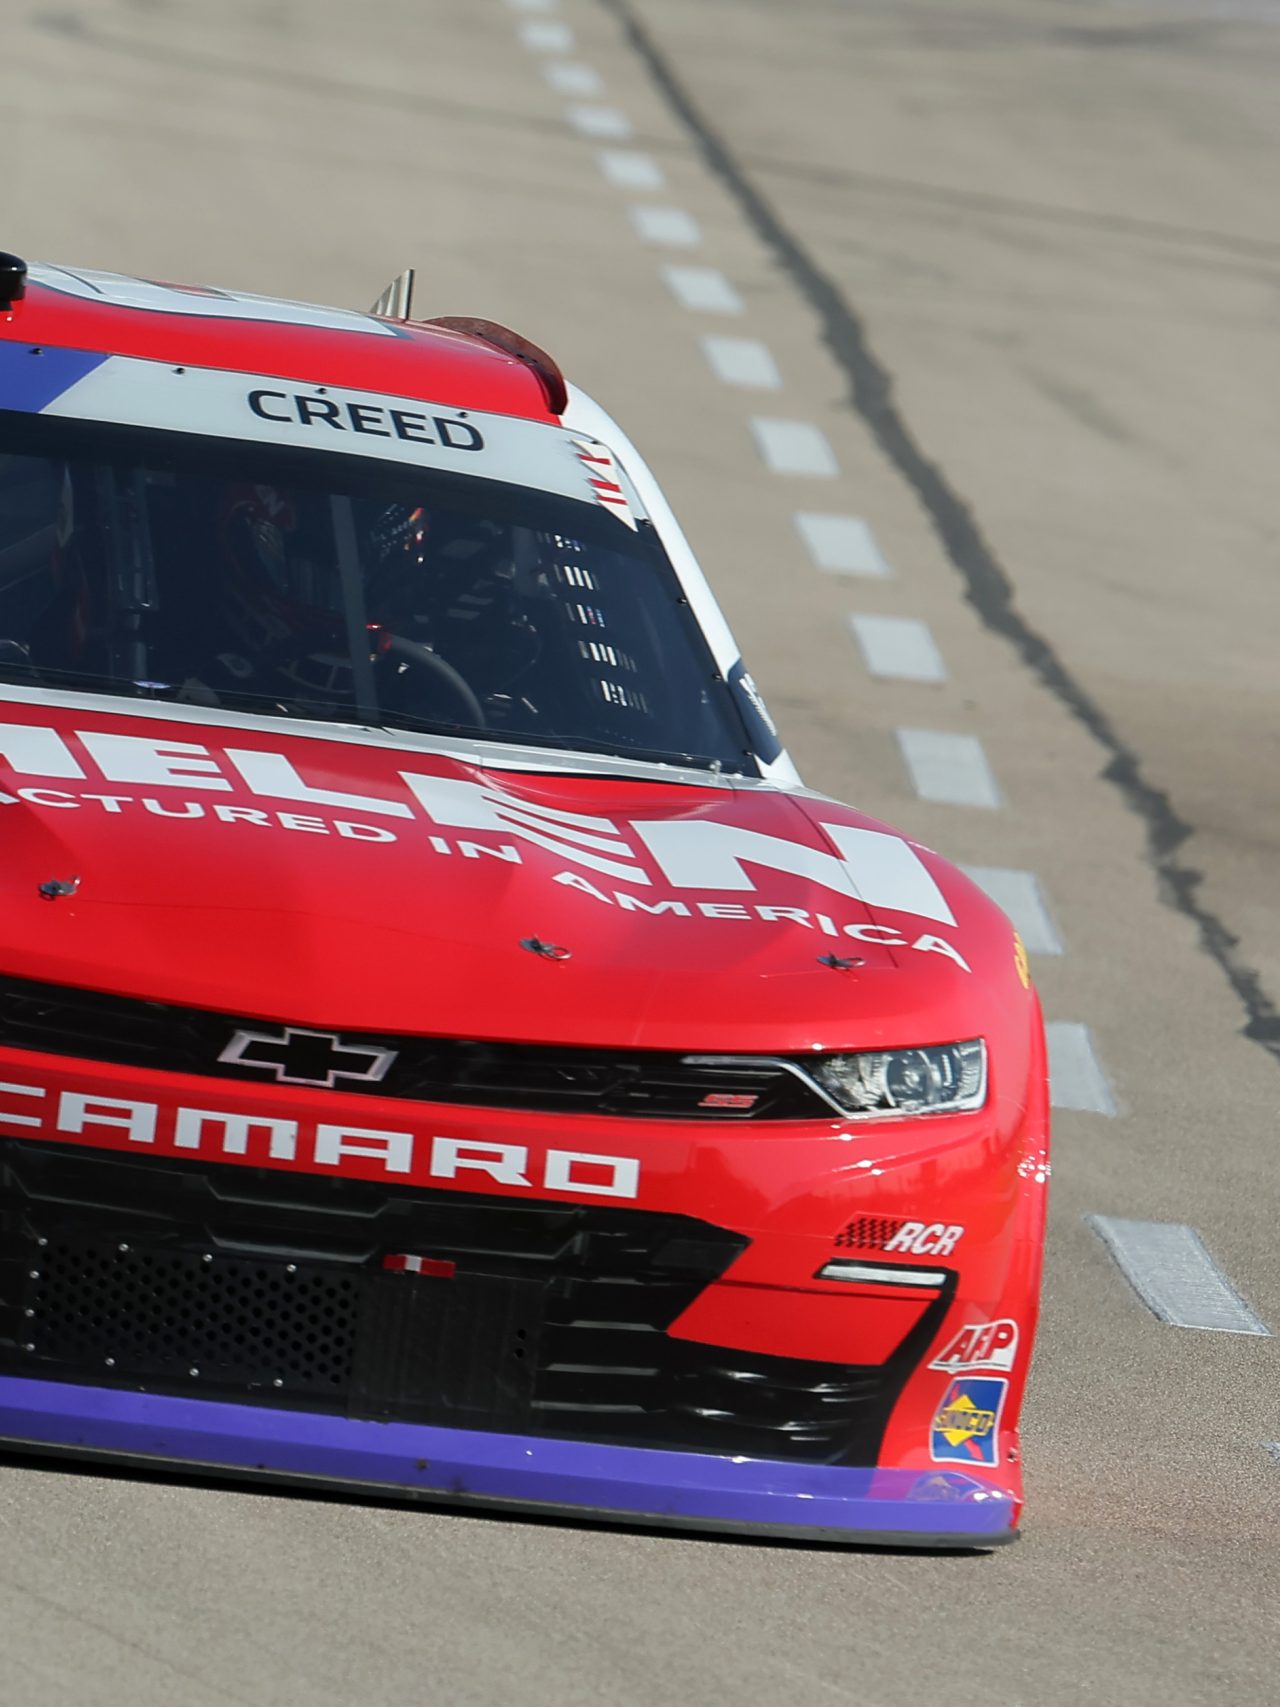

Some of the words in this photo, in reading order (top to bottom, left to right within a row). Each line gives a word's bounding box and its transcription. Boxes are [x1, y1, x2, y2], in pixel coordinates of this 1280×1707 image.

[247, 389, 485, 452] CREED
[427, 836, 523, 865] IN
[552, 872, 972, 973] AMERICA
[884, 1221, 965, 1256] RCR
